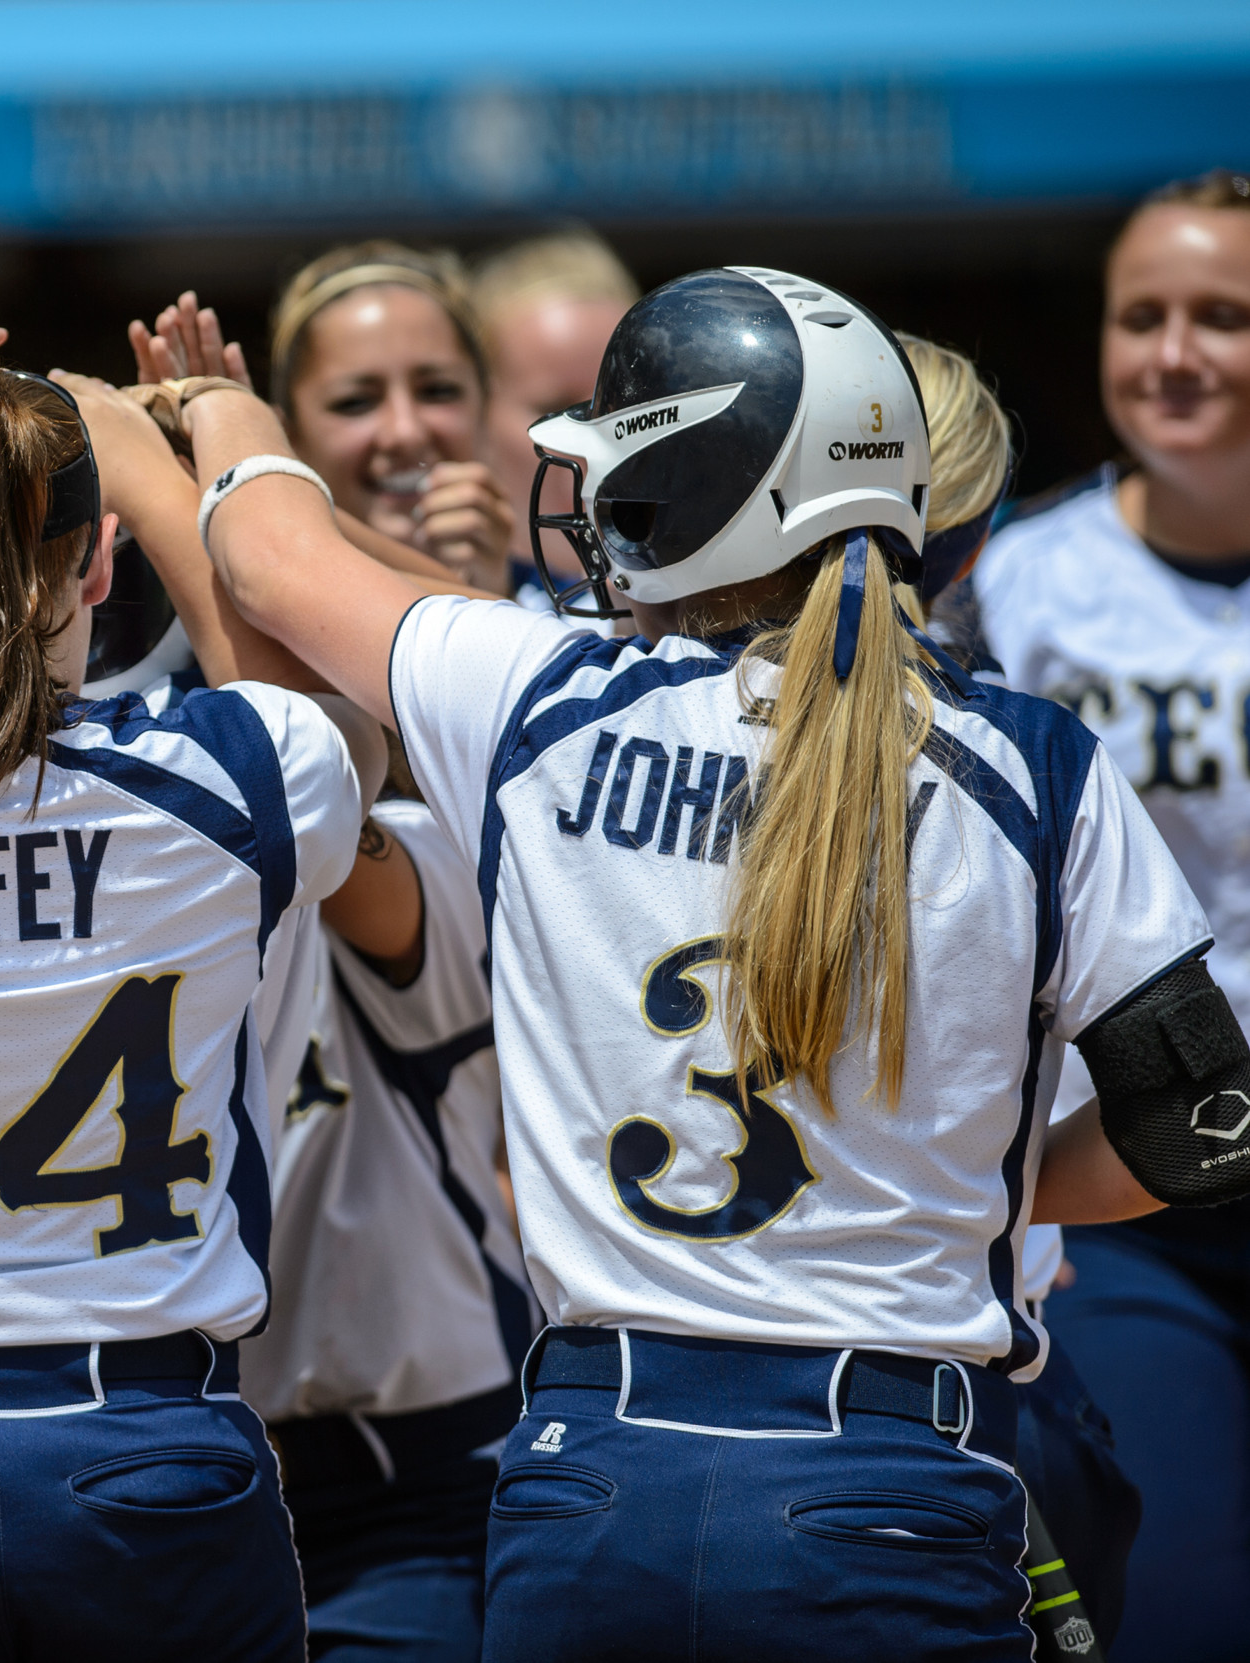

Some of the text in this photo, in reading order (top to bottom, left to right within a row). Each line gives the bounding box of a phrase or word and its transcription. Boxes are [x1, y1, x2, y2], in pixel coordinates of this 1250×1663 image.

[626, 405, 679, 436] WORTH
[871, 403, 882, 432] 3
[848, 440, 905, 460] WORTH
[605, 932, 824, 1244] 3
